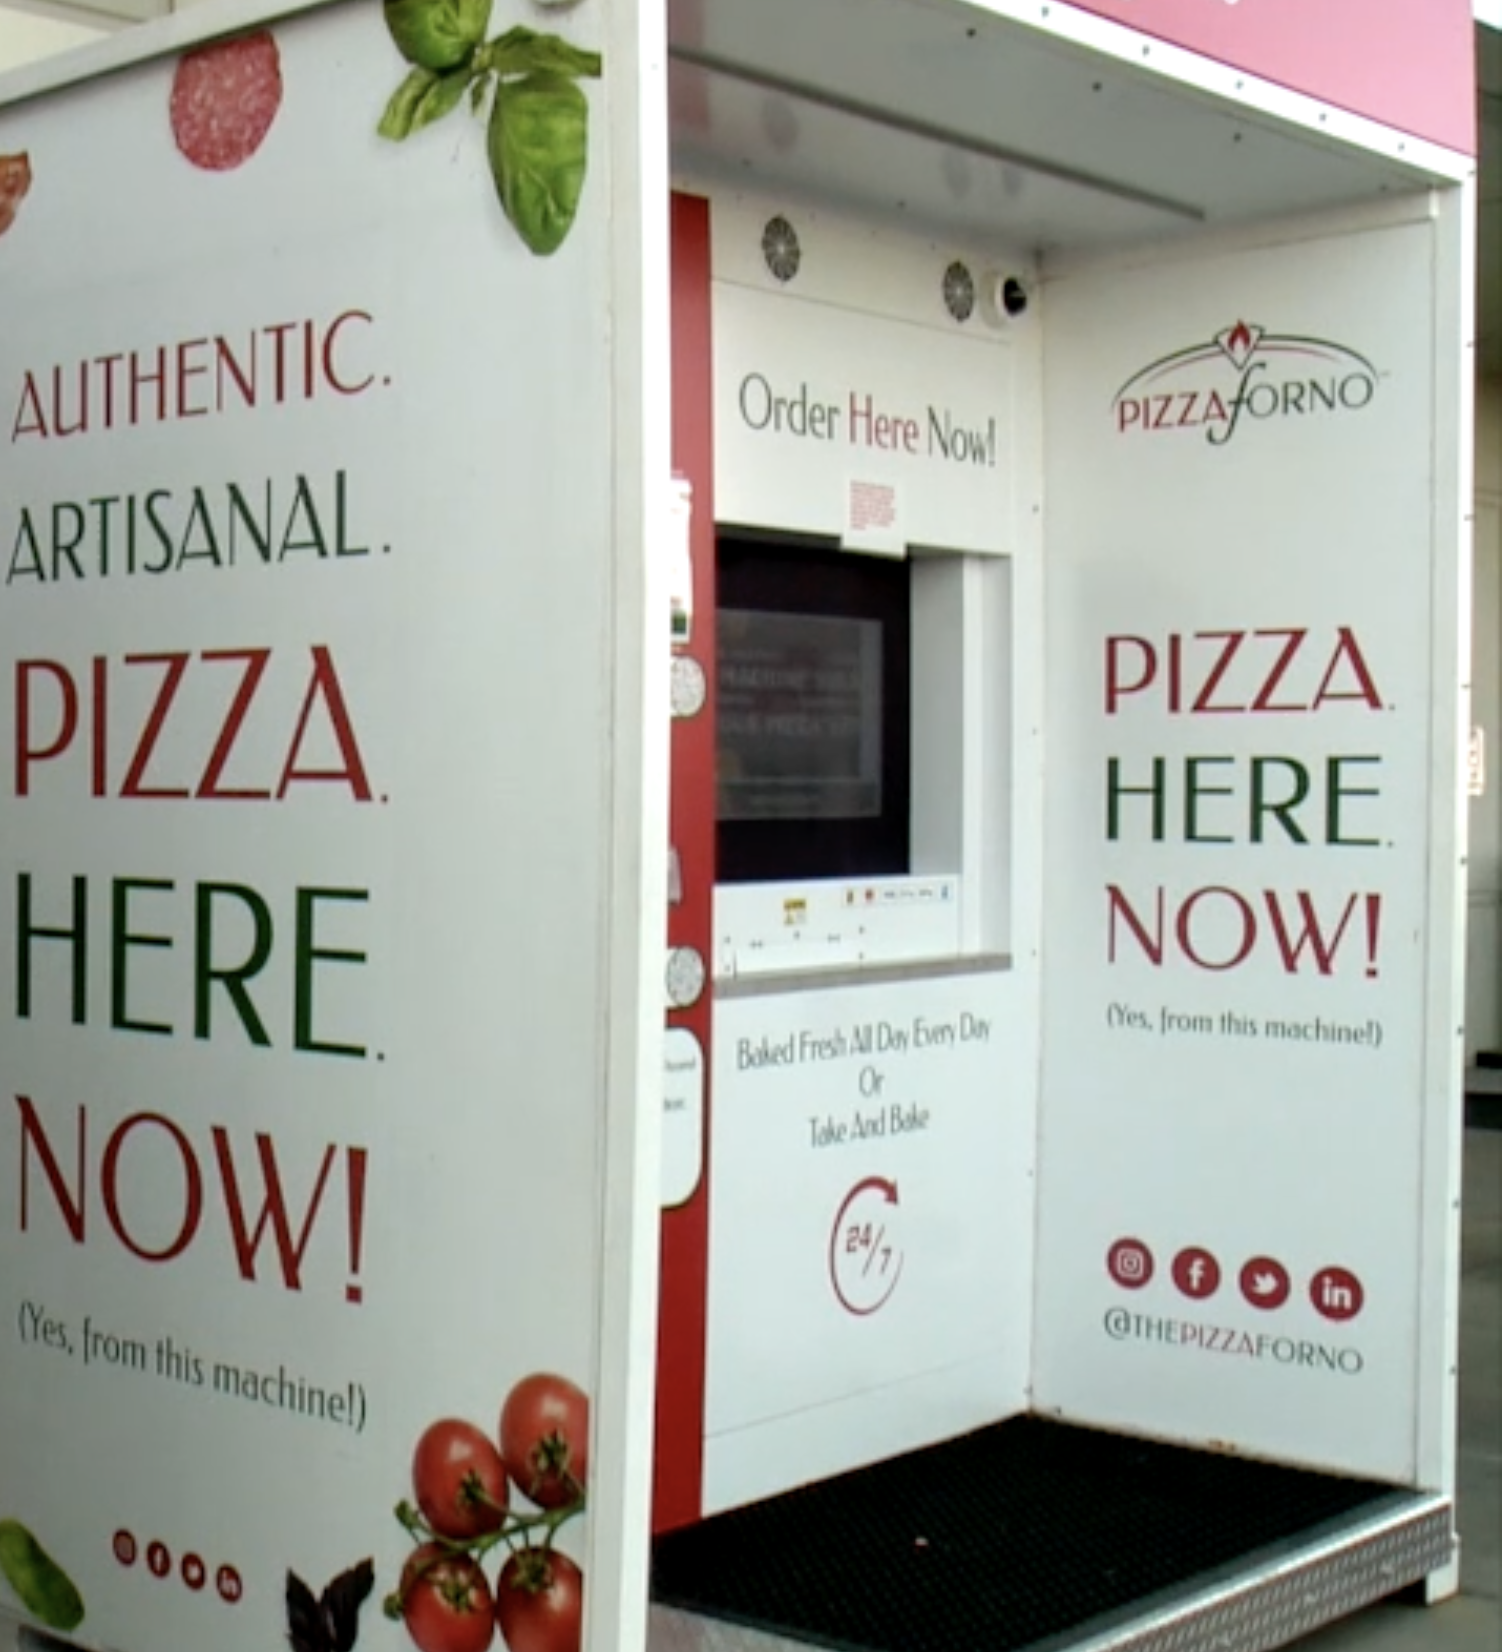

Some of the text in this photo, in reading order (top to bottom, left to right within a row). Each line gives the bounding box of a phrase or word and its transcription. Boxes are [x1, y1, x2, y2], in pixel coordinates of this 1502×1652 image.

[11, 309, 392, 443] AUTHENTIC.
[738, 371, 997, 468] Order Here Now!
[5, 468, 392, 586] ARTISANAL.
[1104, 625, 1396, 715] PIZZA.
[14, 644, 390, 804] PIZZA.
[1106, 755, 1395, 849] HERE.
[15, 871, 386, 1063] HERE.
[1105, 883, 1382, 979] NOW!
[737, 1033, 795, 1071] Baked
[799, 1026, 847, 1062] Fresh
[849, 1024, 873, 1055] All
[877, 1021, 909, 1054] Day
[913, 1015, 956, 1049] Every
[959, 1011, 991, 1042] Day
[1107, 1002, 1383, 1048] (Yes, from this machine!)
[808, 1103, 930, 1148] Take And Bake
[858, 1066, 885, 1097] Or
[14, 1093, 368, 1304] NOW!
[845, 1222, 893, 1278] 24/7
[17, 1299, 367, 1434] (Yes, from this machine!)
[1103, 1305, 1364, 1375] @THEPIZZAFORNO
